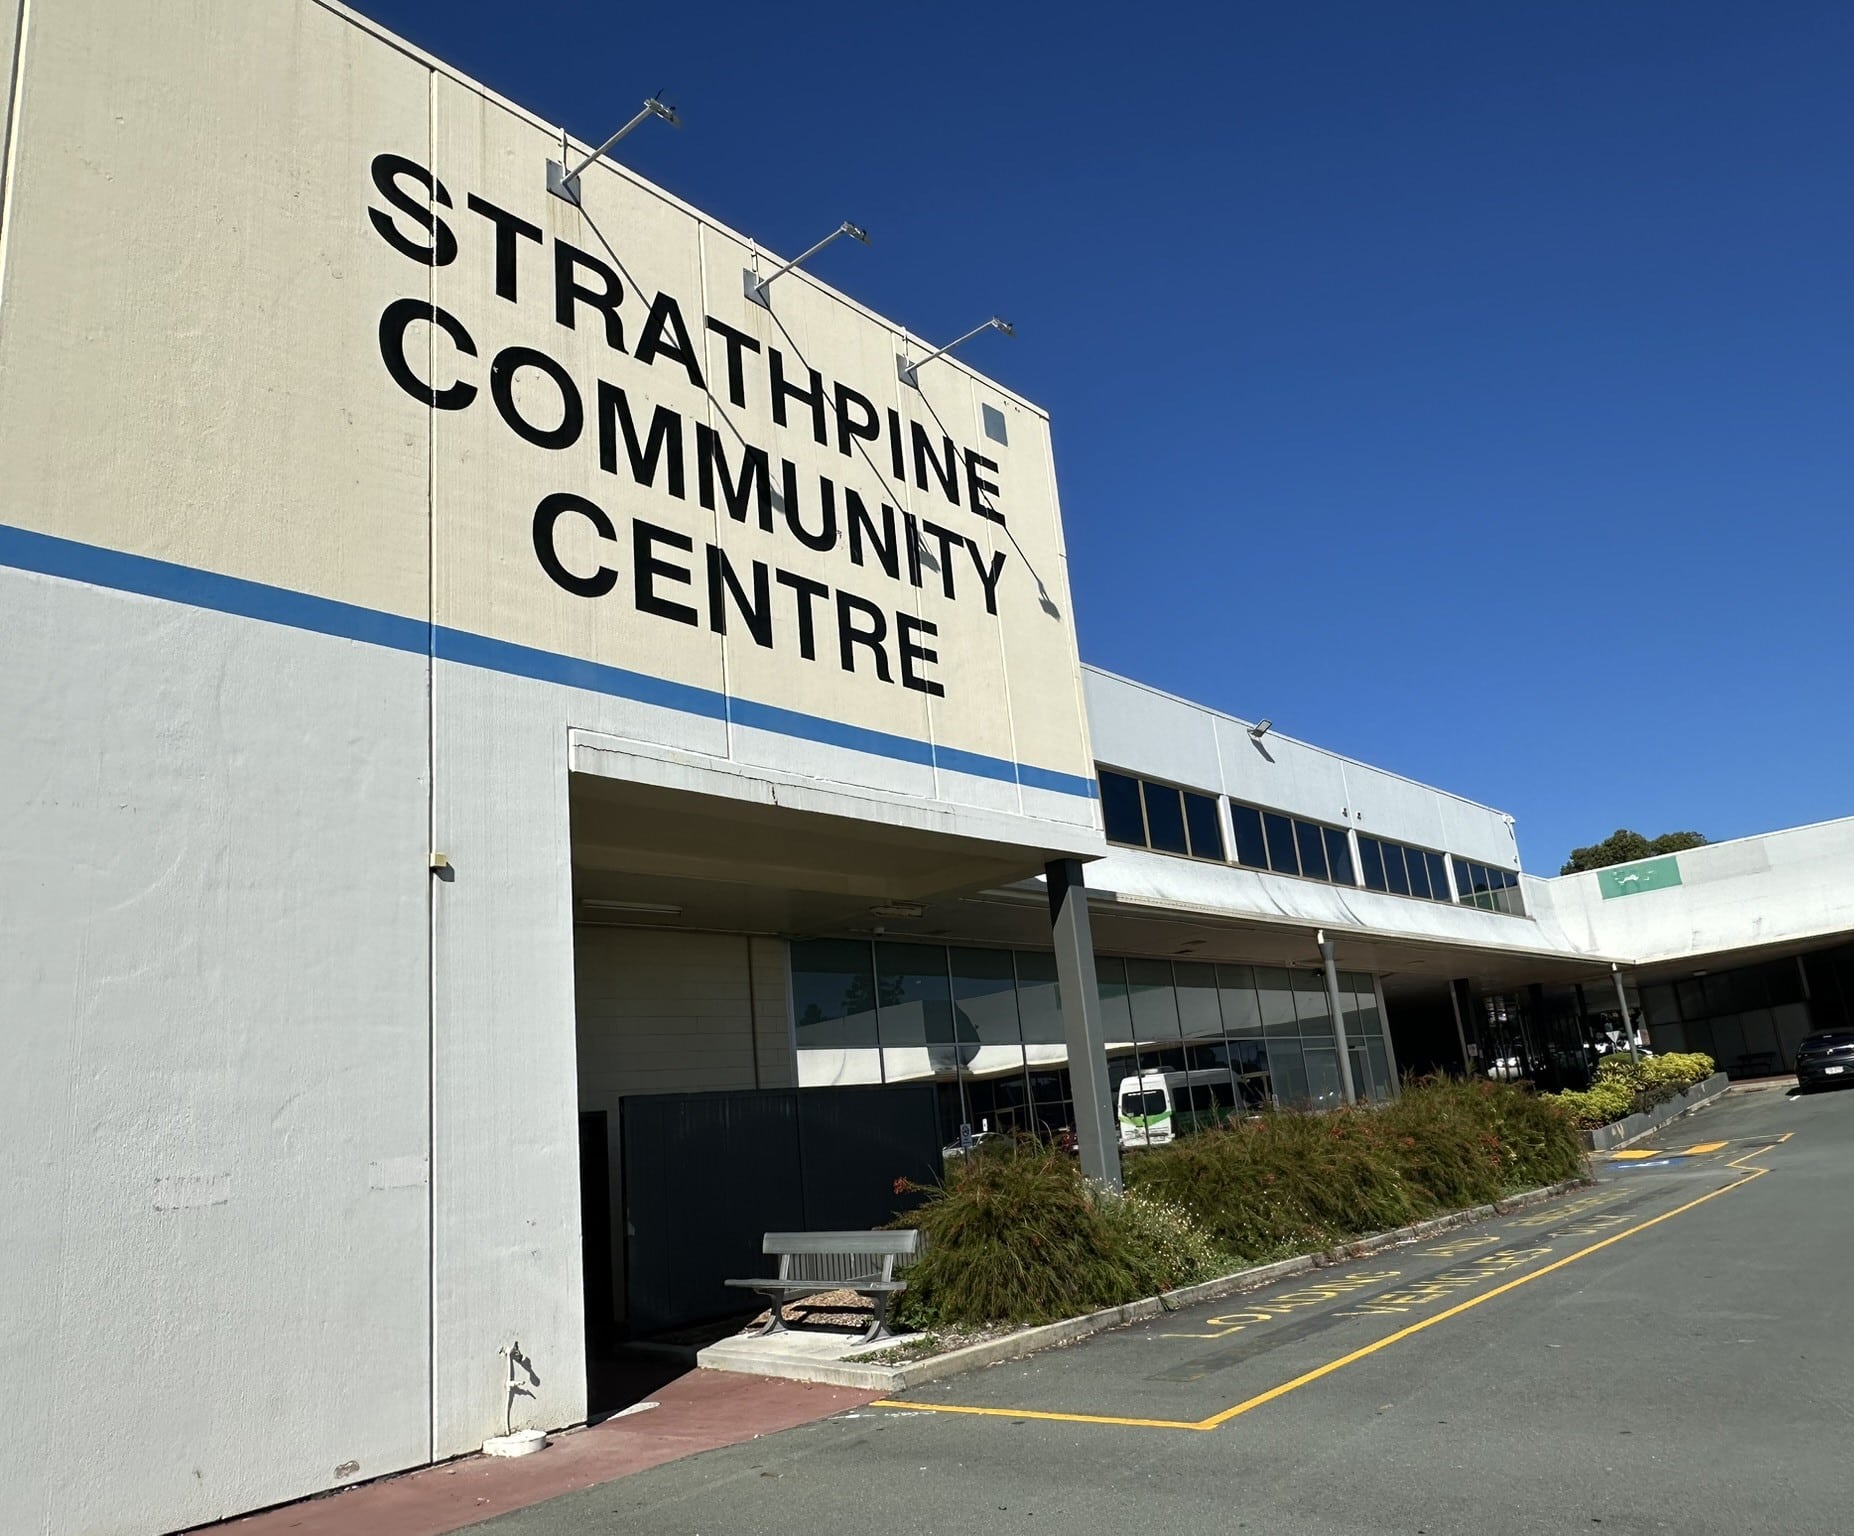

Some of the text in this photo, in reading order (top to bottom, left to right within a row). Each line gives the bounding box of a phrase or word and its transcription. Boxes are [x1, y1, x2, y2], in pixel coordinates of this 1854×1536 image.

[368, 153, 1006, 527] STRATHPINE
[378, 298, 1006, 616] COMMUNITY
[532, 493, 945, 698] CENTRE
[1160, 1236, 1500, 1339] LOADING AND
[1331, 1248, 1553, 1317] VEHICLES
